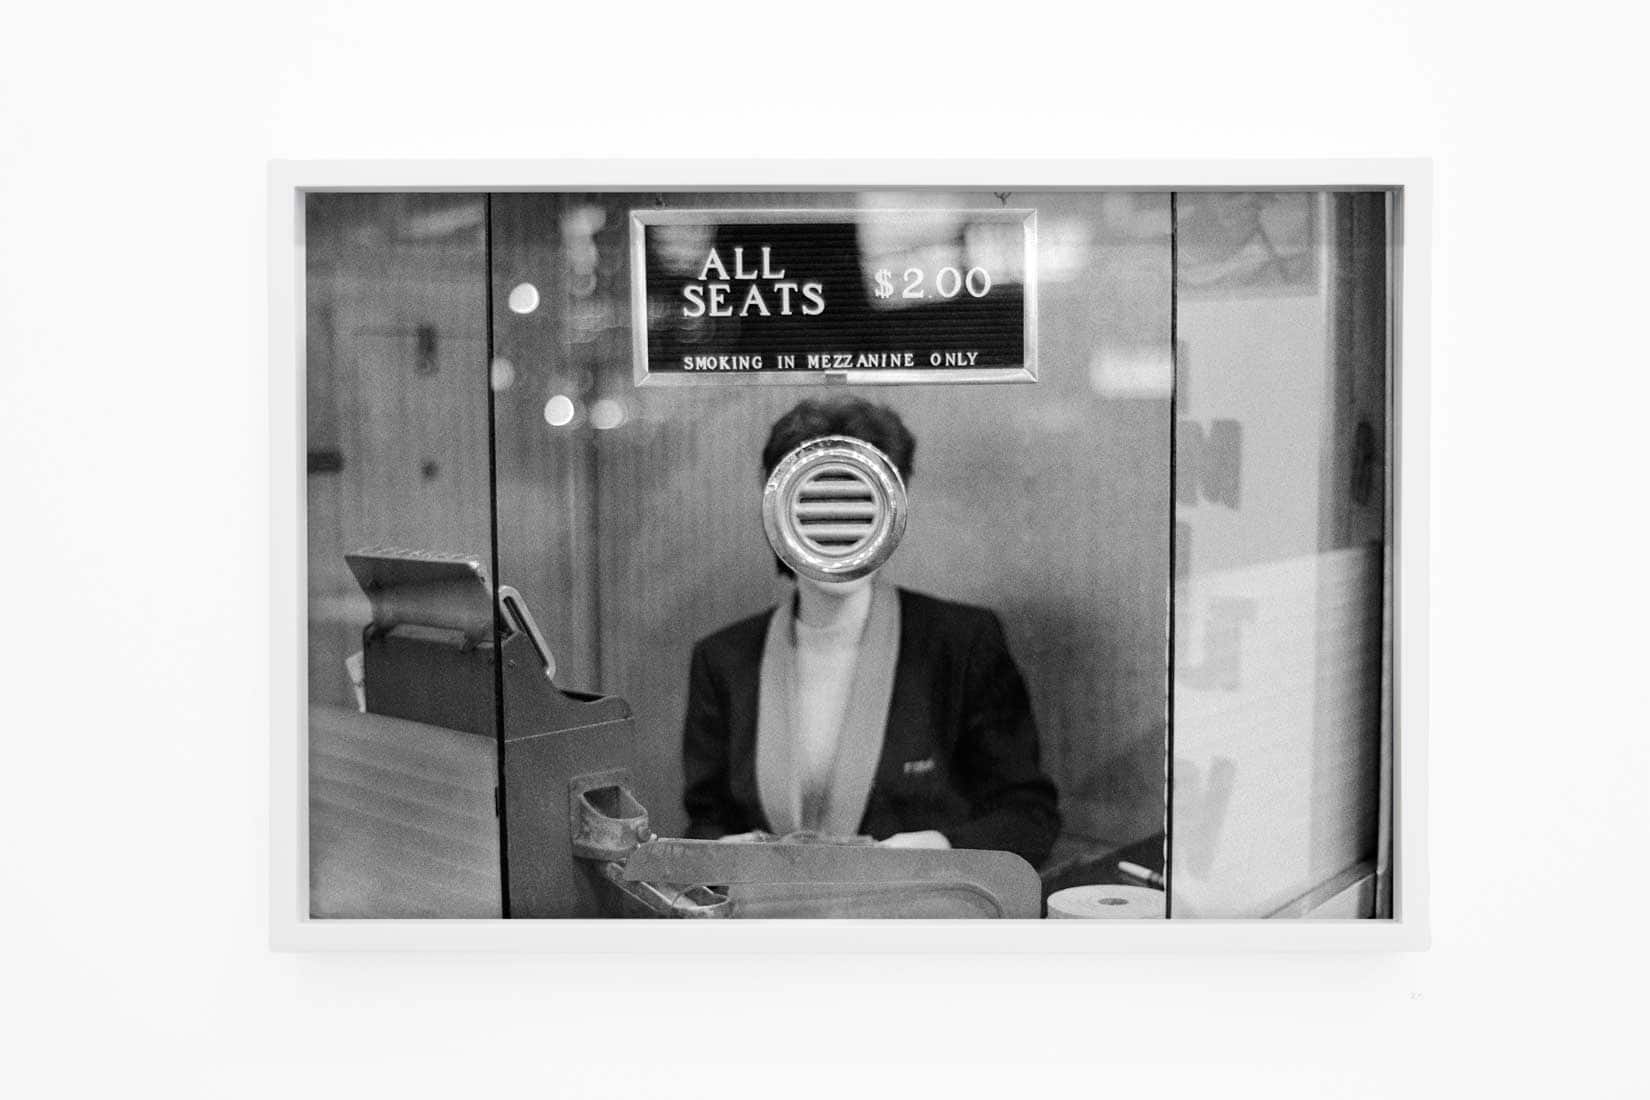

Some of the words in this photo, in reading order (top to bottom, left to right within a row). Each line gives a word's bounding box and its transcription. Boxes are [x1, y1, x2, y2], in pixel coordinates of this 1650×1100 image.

[698, 247, 786, 280] ALL
[874, 266, 992, 299] $2.00
[682, 283, 826, 317] SEATS
[683, 355, 764, 371] SMOKING
[777, 355, 796, 370] IN
[807, 352, 915, 369] MEZZANINE
[930, 351, 979, 367] ONLY
